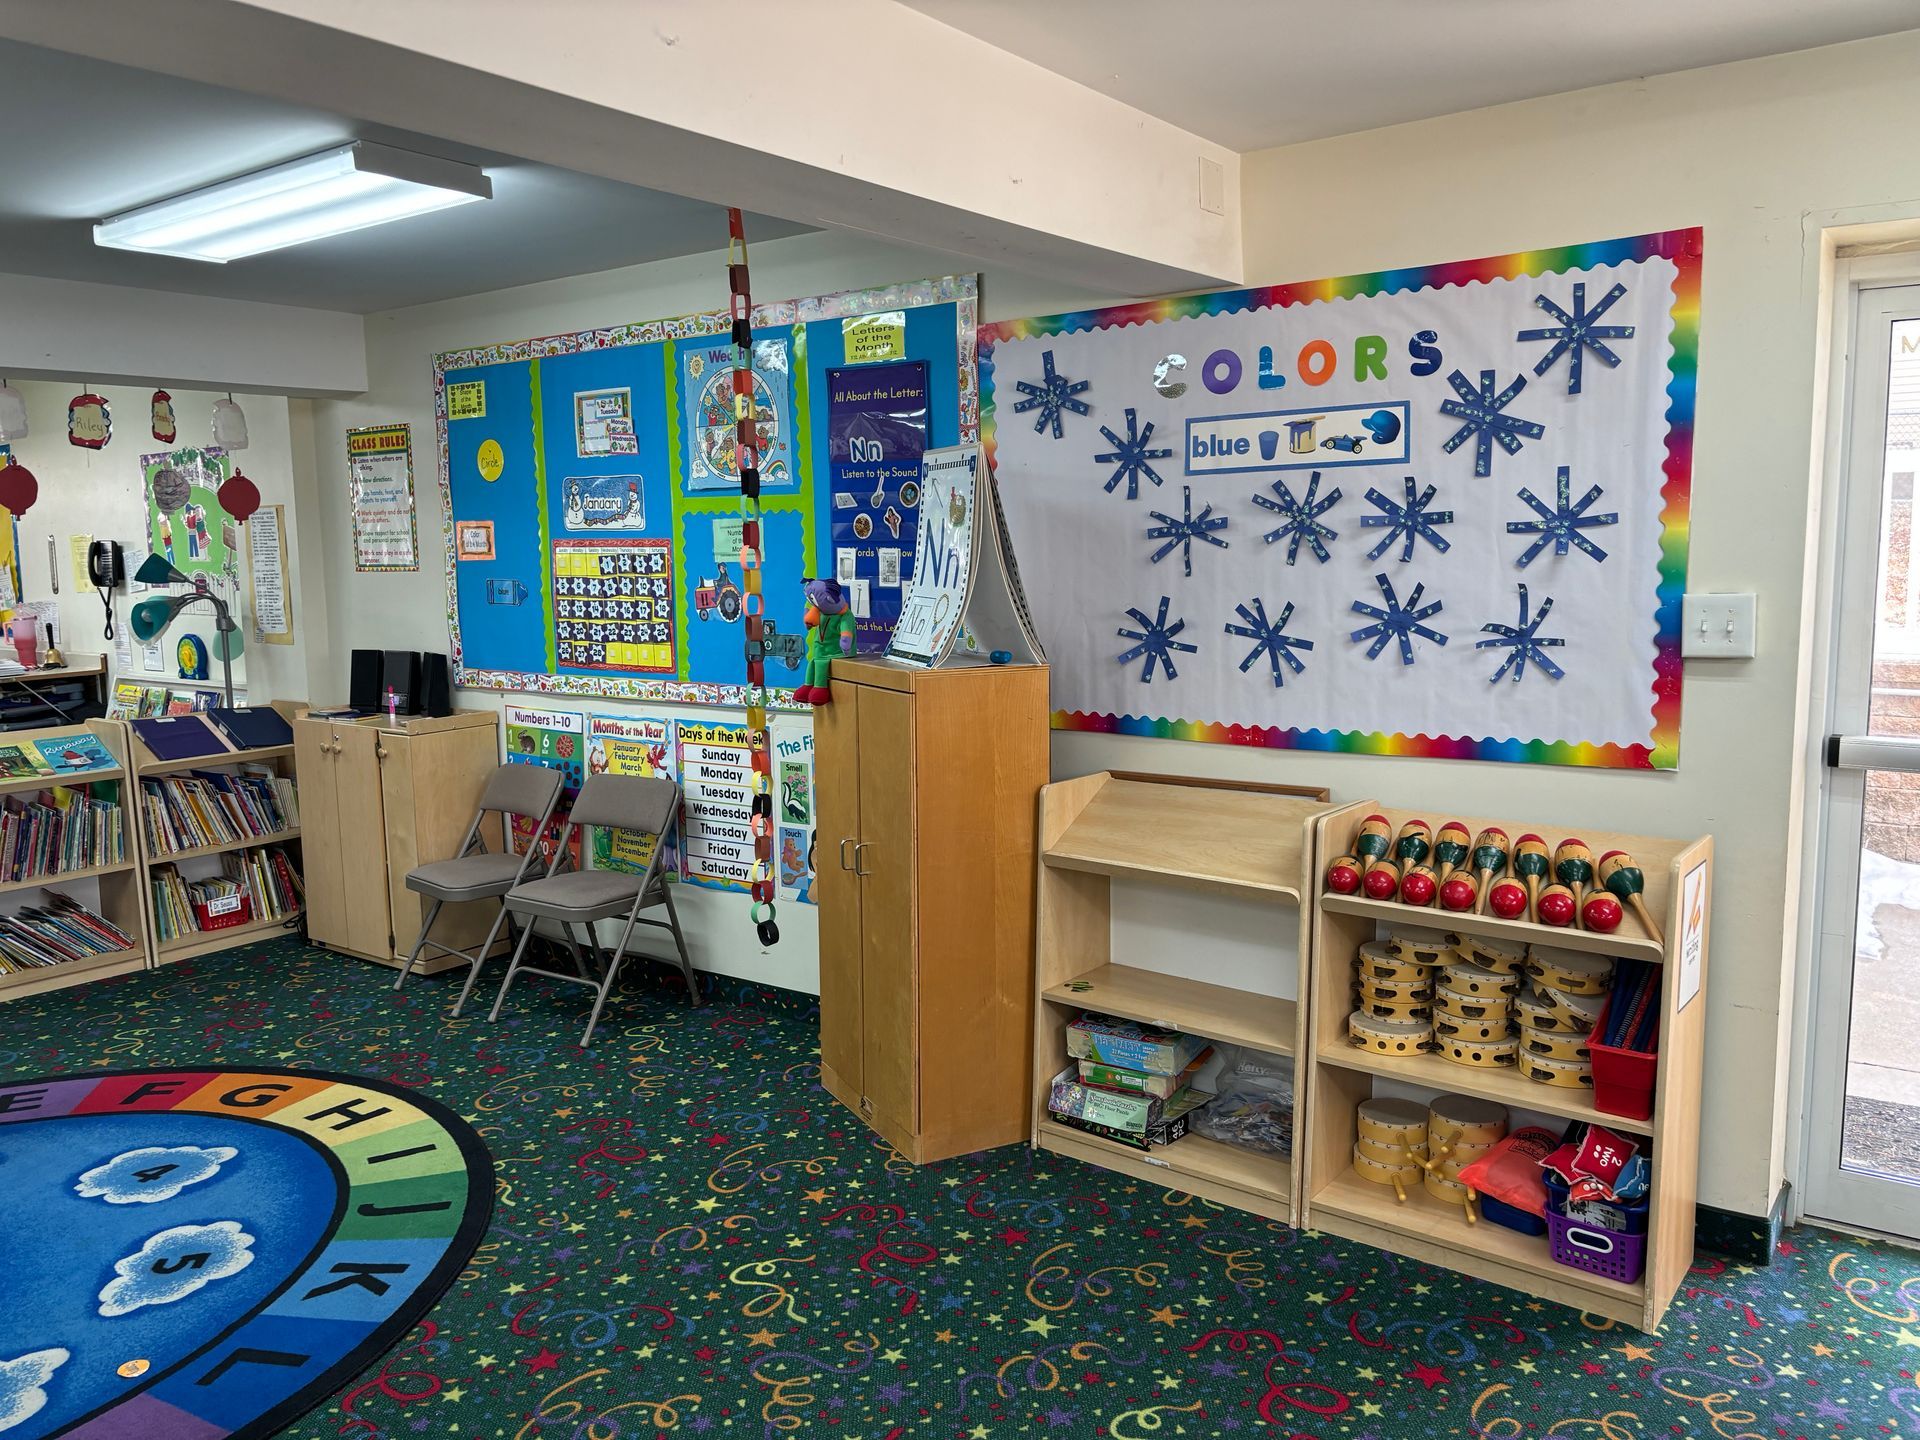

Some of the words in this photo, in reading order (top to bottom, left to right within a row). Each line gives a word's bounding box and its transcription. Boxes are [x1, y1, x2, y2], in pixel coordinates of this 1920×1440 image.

[852, 325, 895, 335] Letters
[855, 342, 893, 352] Month
[1153, 329, 1443, 399] COLORS
[834, 392, 844, 403] All
[846, 390, 871, 402] About
[874, 388, 887, 399] the
[891, 387, 923, 398] Letter:
[76, 416, 103, 437] Riley
[352, 437, 376, 450] CLASS
[380, 435, 405, 448] RULES
[851, 438, 882, 463] Nn
[1192, 433, 1250, 458] blue
[842, 469, 864, 479] Listen
[866, 469, 875, 477] to
[877, 468, 890, 477] the
[892, 466, 918, 477] Sound
[584, 494, 622, 513] January
[920, 518, 959, 589] Nn
[701, 593, 708, 606] 11
[871, 622, 883, 632] the
[911, 604, 925, 635] Nn
[784, 638, 795, 653] 12
[515, 711, 550, 726] Numbers
[593, 720, 624, 735] Months
[633, 728, 643, 736] the
[644, 723, 664, 738] Year
[679, 727, 702, 742] Days
[706, 730, 716, 740] of
[718, 731, 733, 742] the
[43, 735, 96, 756] Runaway
[508, 730, 513, 742] 1
[543, 734, 549, 747] 6
[777, 739, 801, 758] The
[803, 734, 814, 750] Fi
[613, 743, 641, 754] January
[614, 752, 645, 763] February
[702, 749, 740, 763] Sunday
[620, 762, 642, 772] March
[701, 766, 743, 783] Monday
[786, 763, 803, 773] Smell
[700, 785, 745, 803] Tuesday
[692, 803, 754, 822] Wednesday
[620, 828, 648, 838] October
[700, 822, 748, 842] Thursday
[784, 828, 802, 838] Touch
[616, 843, 649, 858] December
[617, 835, 651, 849] November
[707, 843, 741, 862] Friday
[701, 860, 749, 879] Saturday
[0, 1088, 48, 1113] E
[121, 1081, 186, 1105] F
[219, 1084, 293, 1107] G
[304, 1098, 392, 1131] H
[366, 1143, 438, 1165] I
[1600, 1146, 1614, 1167] two
[1612, 1156, 1622, 1167] 2
[130, 1163, 180, 1184] 4
[358, 1201, 452, 1217] J
[151, 1252, 212, 1275] 5
[302, 1262, 410, 1301] K
[194, 1347, 311, 1386] L
